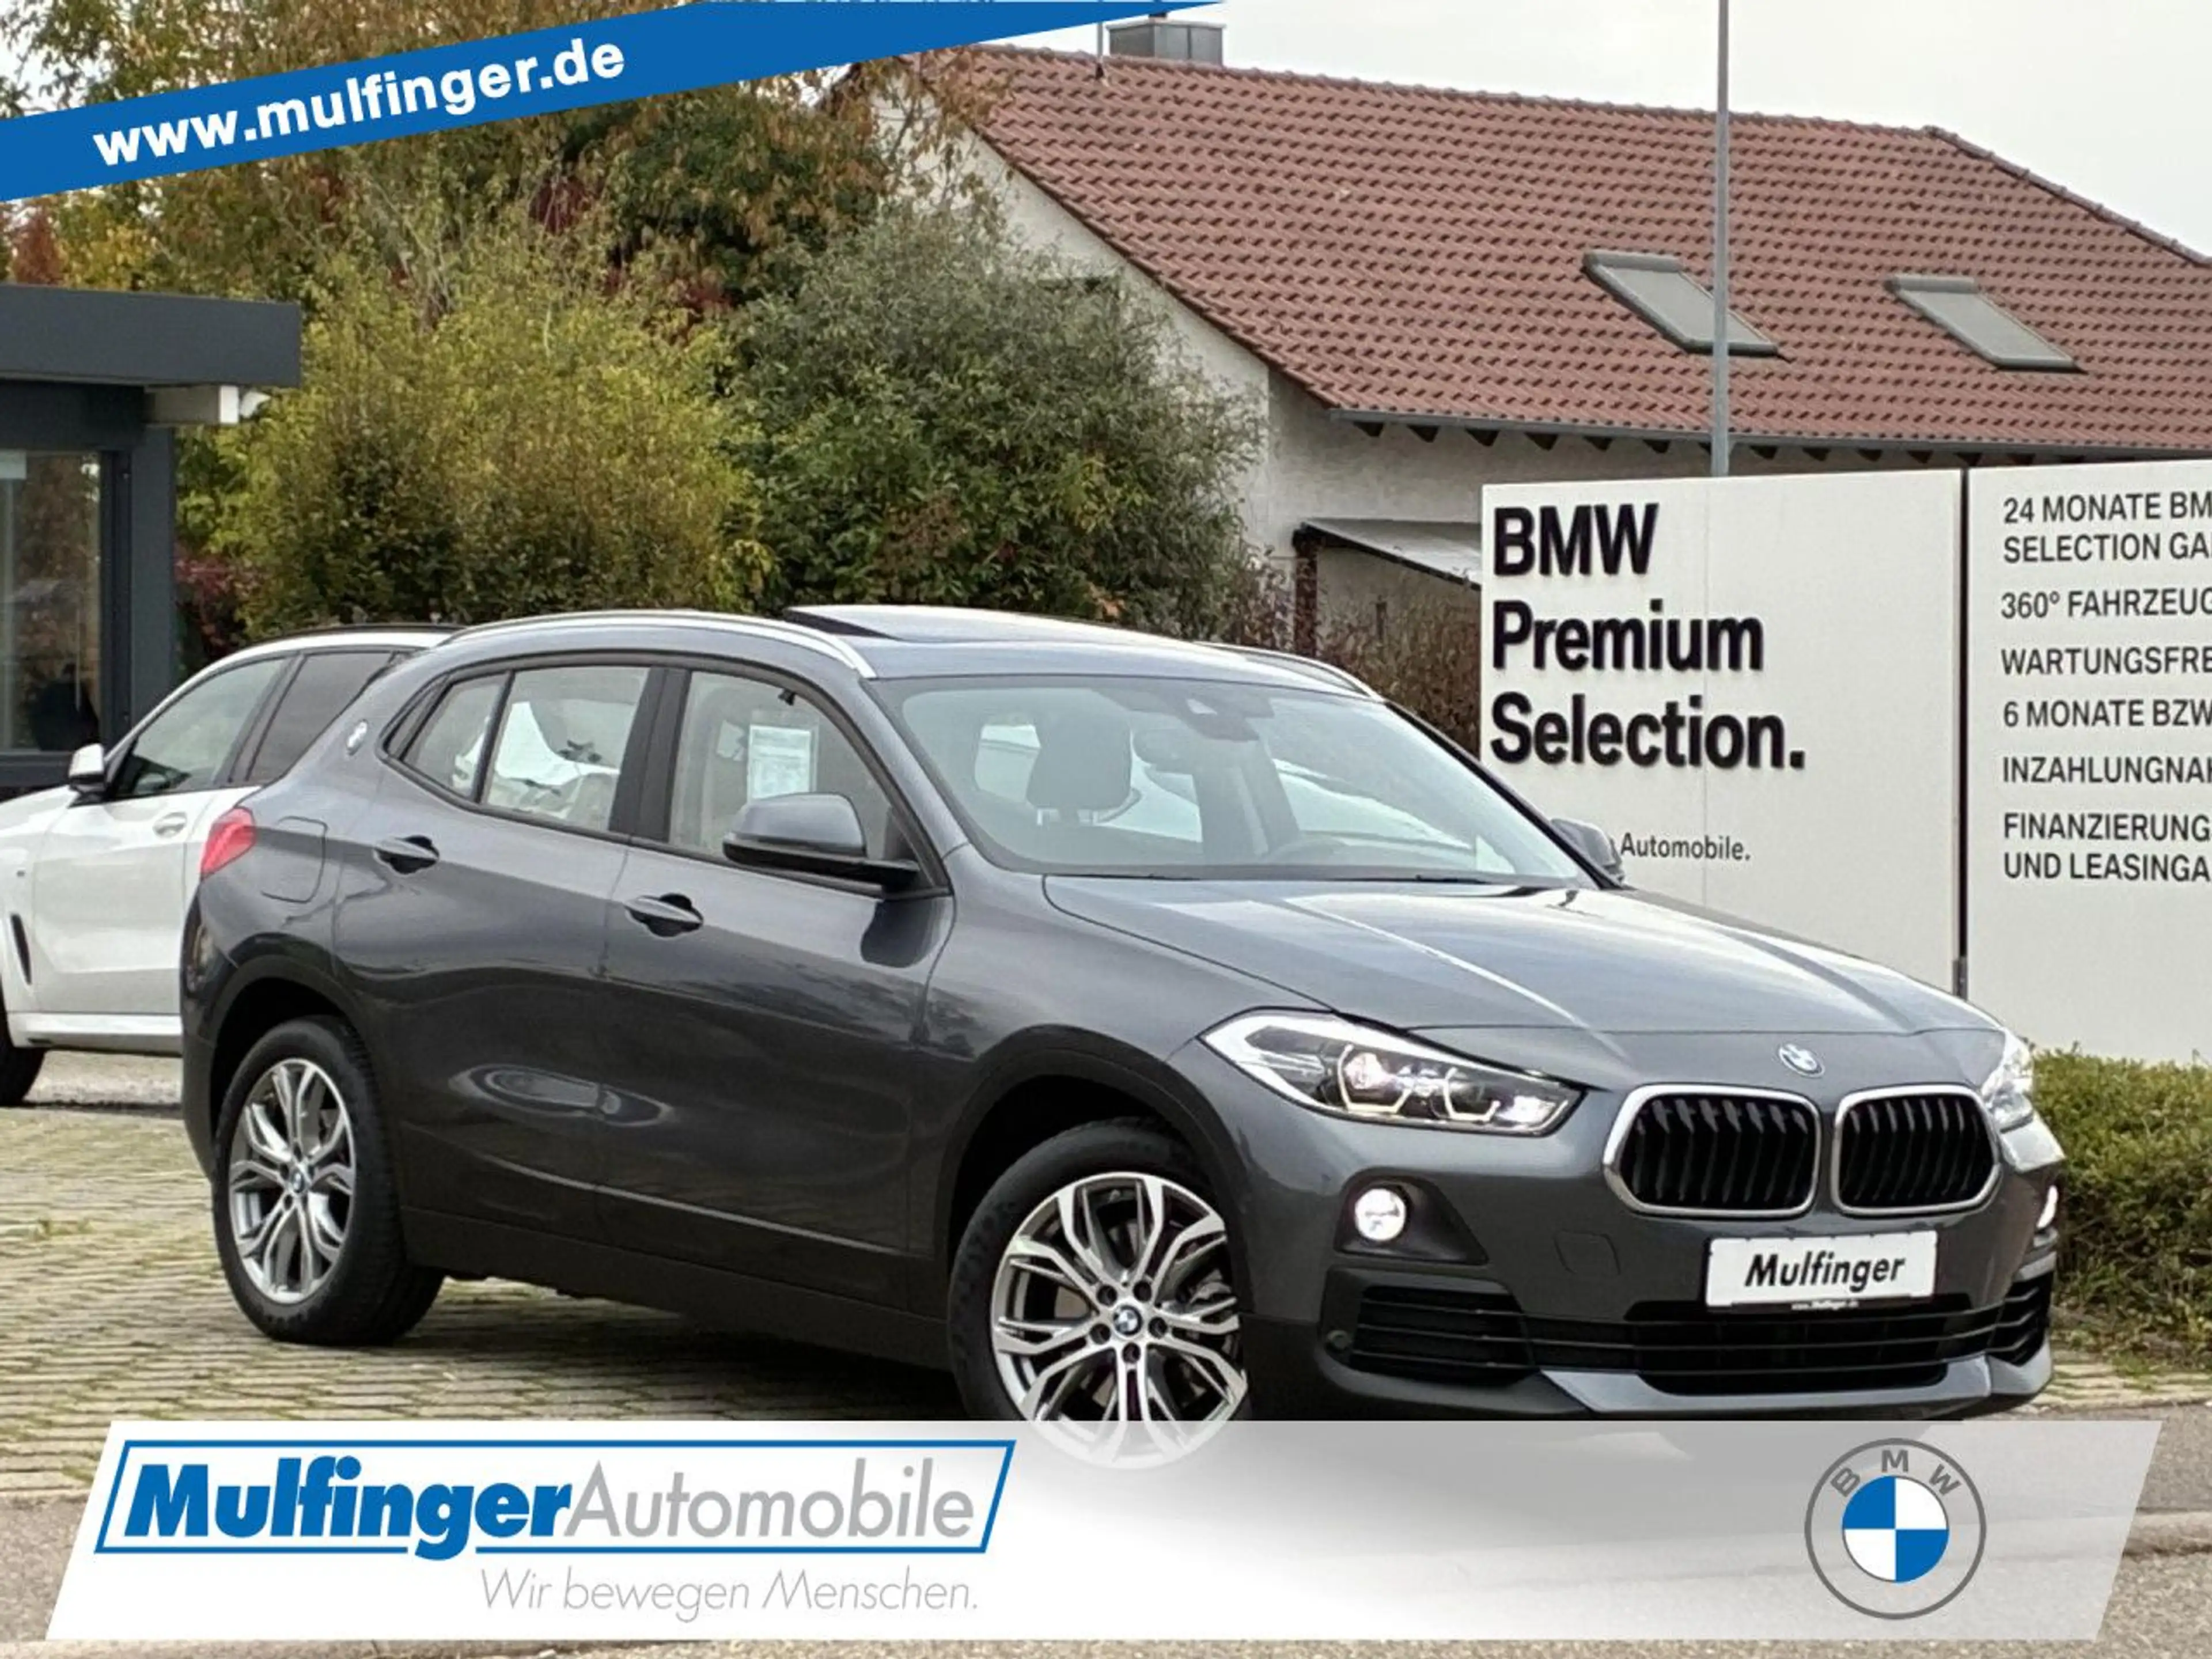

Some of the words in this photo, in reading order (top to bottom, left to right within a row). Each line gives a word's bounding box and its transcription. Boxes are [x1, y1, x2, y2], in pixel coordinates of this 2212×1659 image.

[2003, 497, 2035, 524] 24
[2042, 493, 2161, 522] MONATE
[1493, 502, 1660, 577] BMW
[2003, 532, 2160, 563] SELECTION
[2169, 531, 2212, 560] GA
[1493, 598, 1764, 671] Premium
[2003, 700, 2018, 728] 6
[2026, 699, 2145, 727] MONATE
[2153, 698, 2212, 726] BZW
[1490, 691, 1805, 769] Selection.
[2004, 812, 2211, 842] FINANZIERUNG
[1620, 832, 1751, 861] Automobile.
[2004, 852, 2061, 879] UND
[2070, 852, 2211, 882] LEASINGA
[1744, 1251, 1906, 1293] Mulfinger
